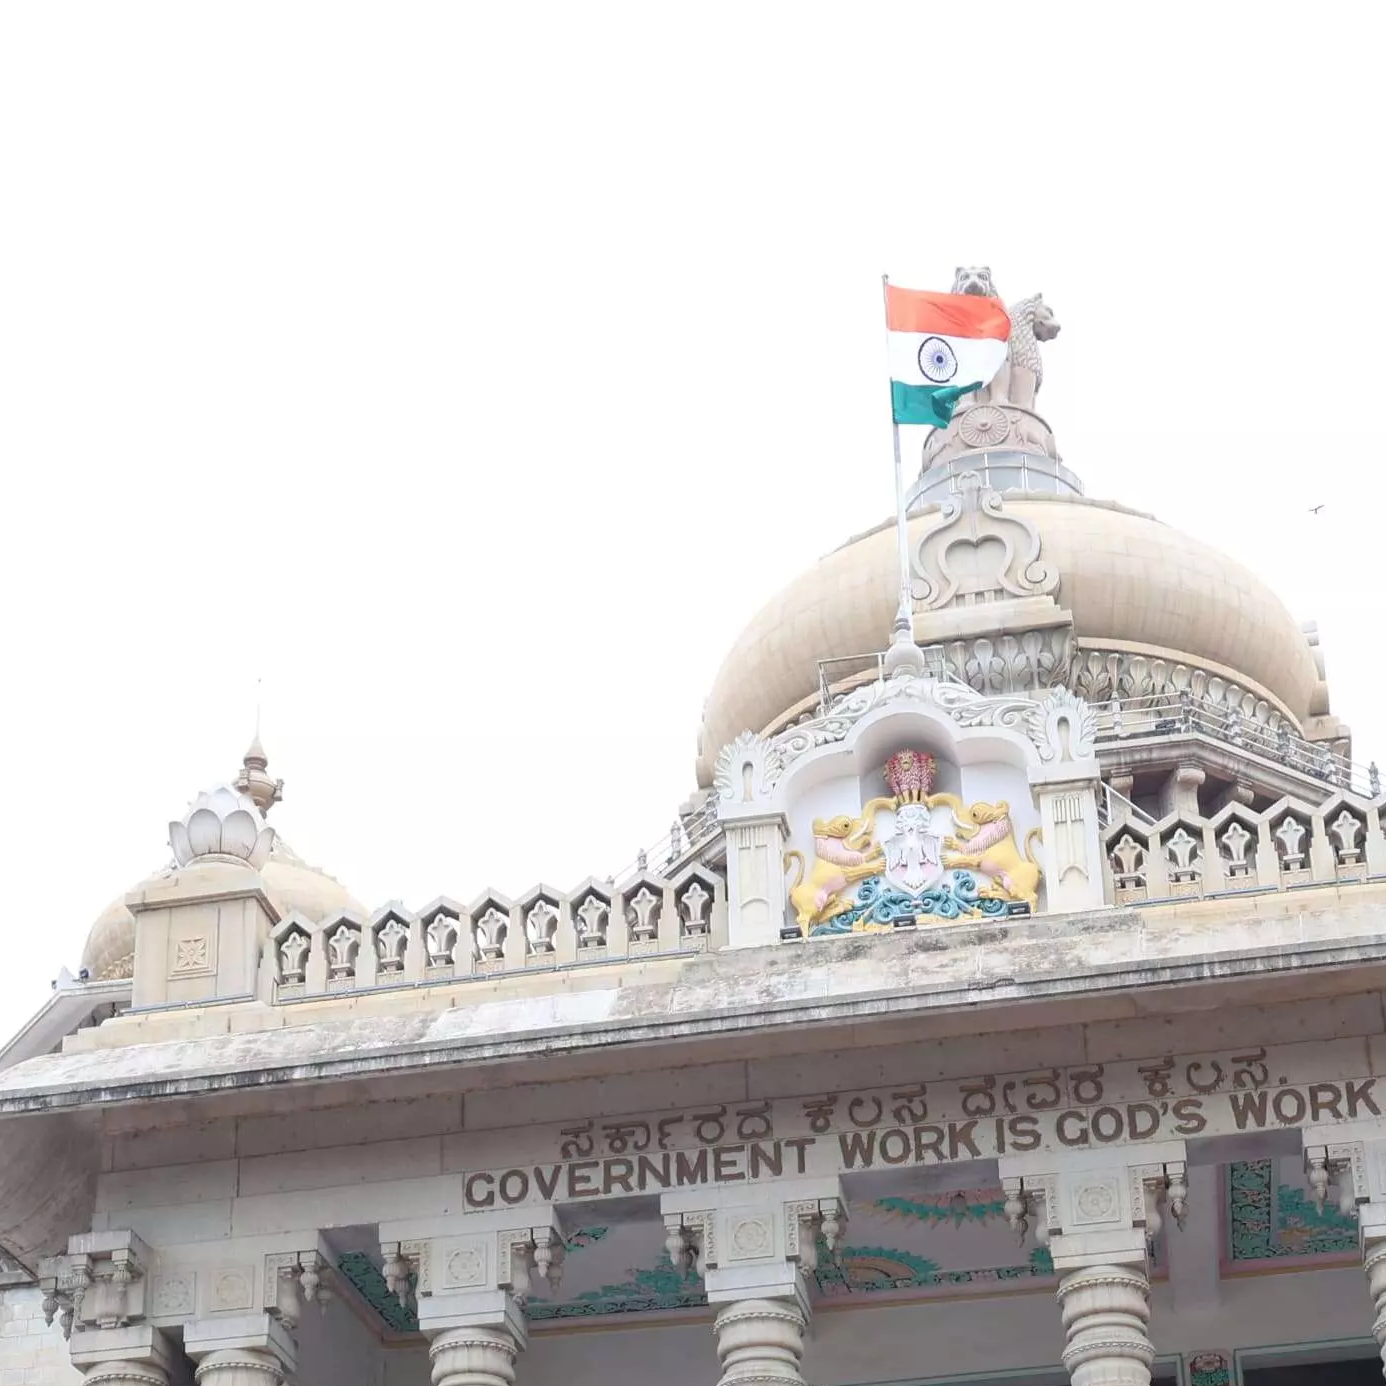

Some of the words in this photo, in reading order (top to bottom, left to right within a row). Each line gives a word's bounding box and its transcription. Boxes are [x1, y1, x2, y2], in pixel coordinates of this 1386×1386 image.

[464, 1136, 816, 1208] GOVERNMENT
[838, 1118, 981, 1170] WORK
[995, 1114, 1042, 1153] IS
[1055, 1098, 1208, 1148] GOD'S
[560, 1099, 774, 1158] ಸರ್ಕಾರದ
[959, 1064, 1104, 1118] ದೇವರ
